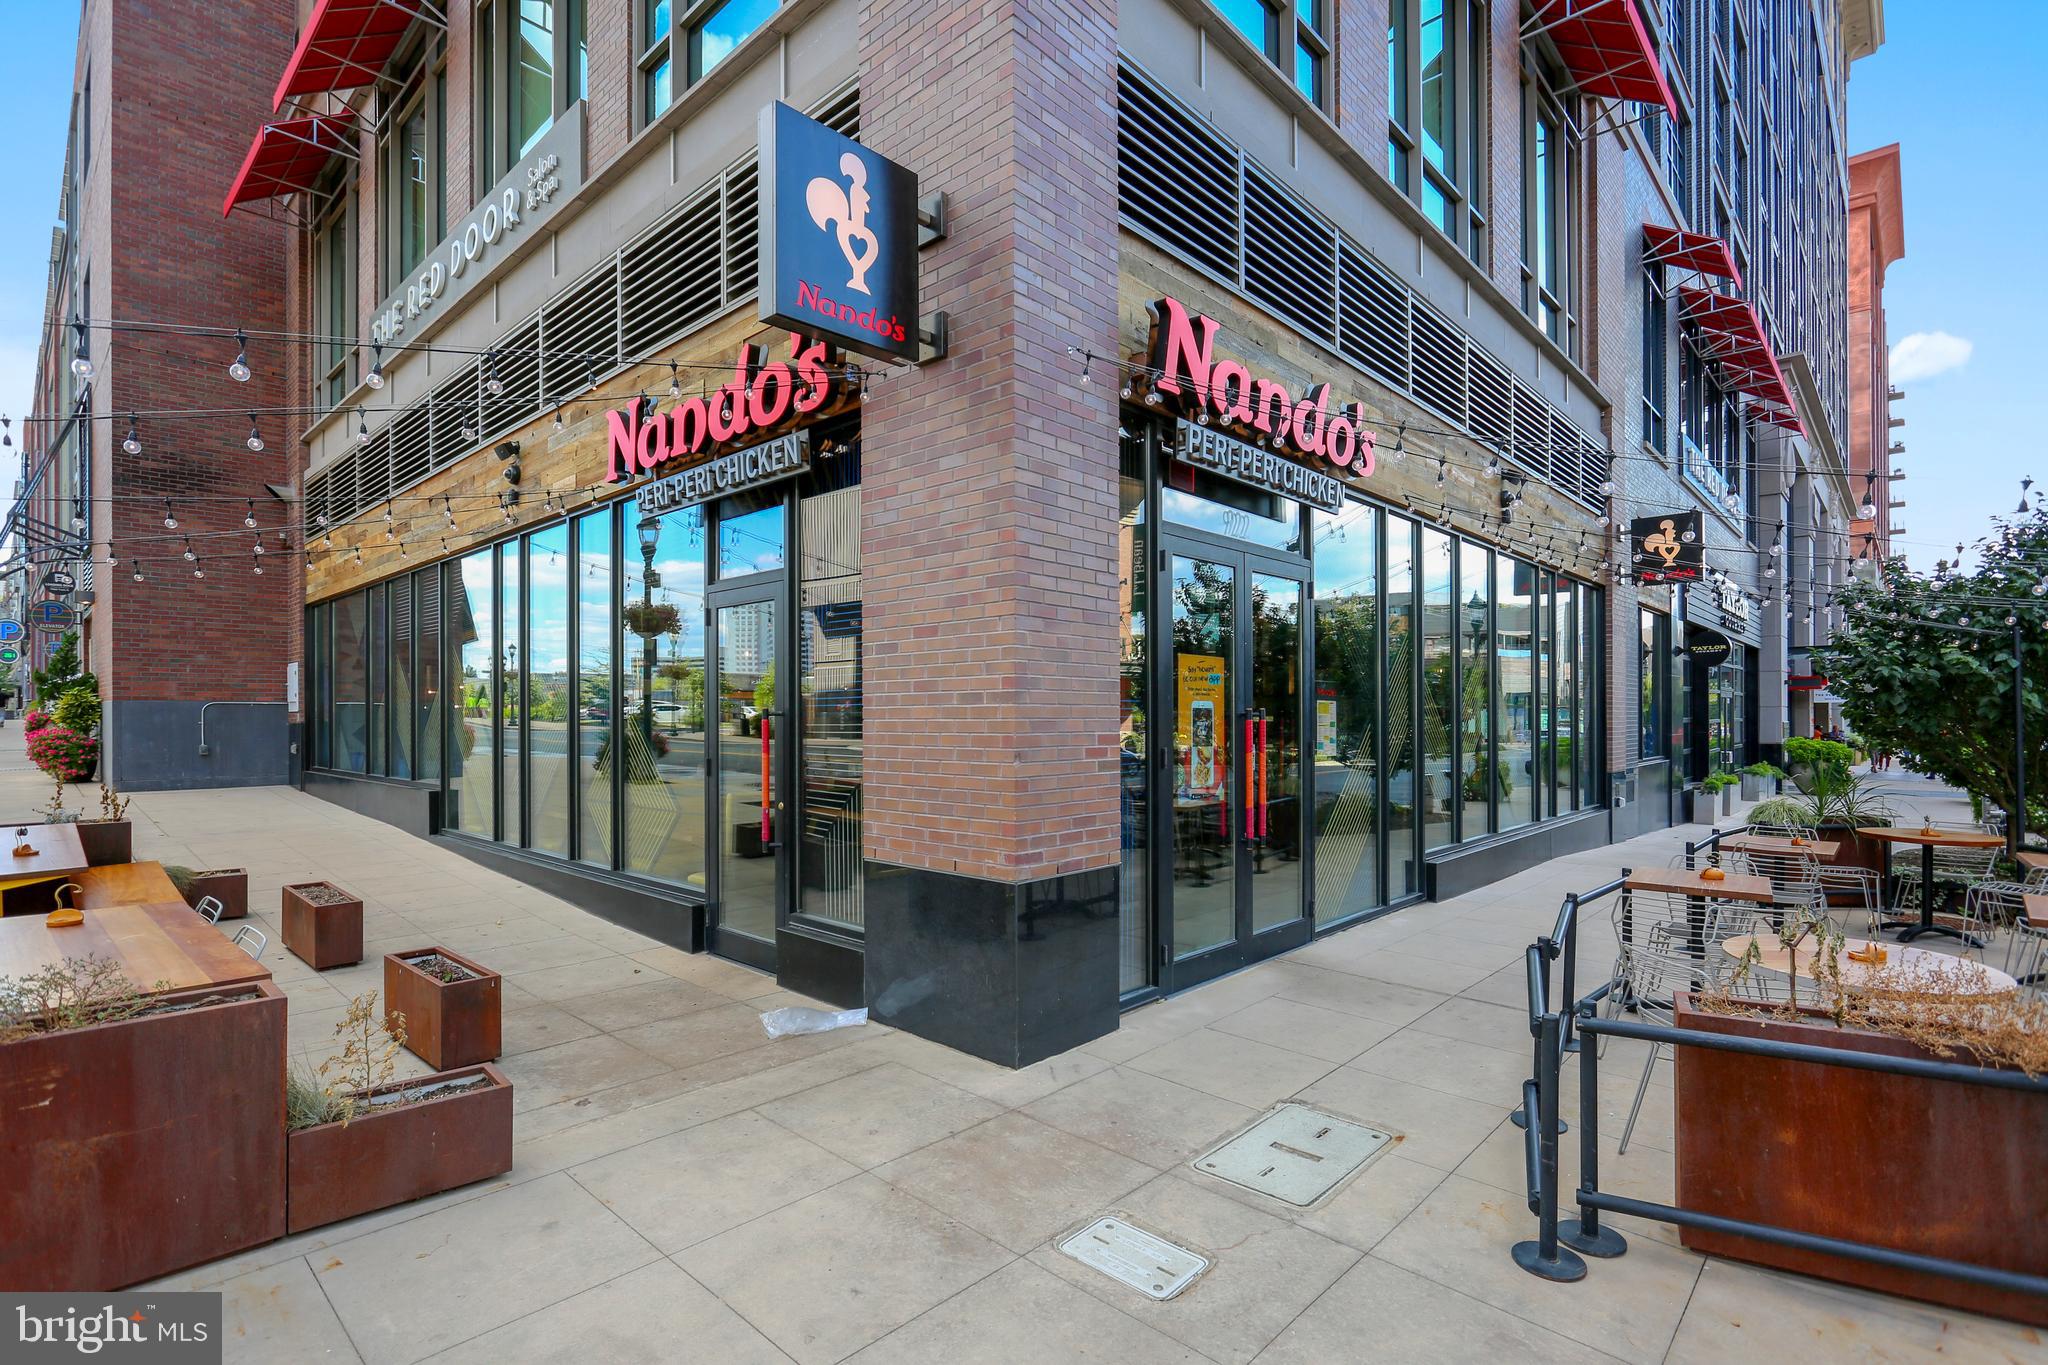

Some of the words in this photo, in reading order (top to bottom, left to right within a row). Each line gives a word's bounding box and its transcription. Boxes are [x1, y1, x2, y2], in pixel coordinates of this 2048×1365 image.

[527, 154, 559, 187] Salon
[527, 189, 538, 210] &
[536, 176, 559, 203] Spa
[372, 300, 403, 345] THE
[408, 262, 446, 320] RED
[451, 187, 520, 279] DOOR
[796, 279, 906, 343] Nando's
[605, 332, 829, 483] Nando's
[1158, 297, 1377, 477] Nando's
[635, 465, 711, 512] PERI-PERI
[715, 435, 802, 487] CHICKEN
[1185, 424, 1280, 489] PERI-PERI
[1283, 463, 1346, 508] CHICKEN
[1, 623, 19, 640] P
[44, 604, 64, 622] P
